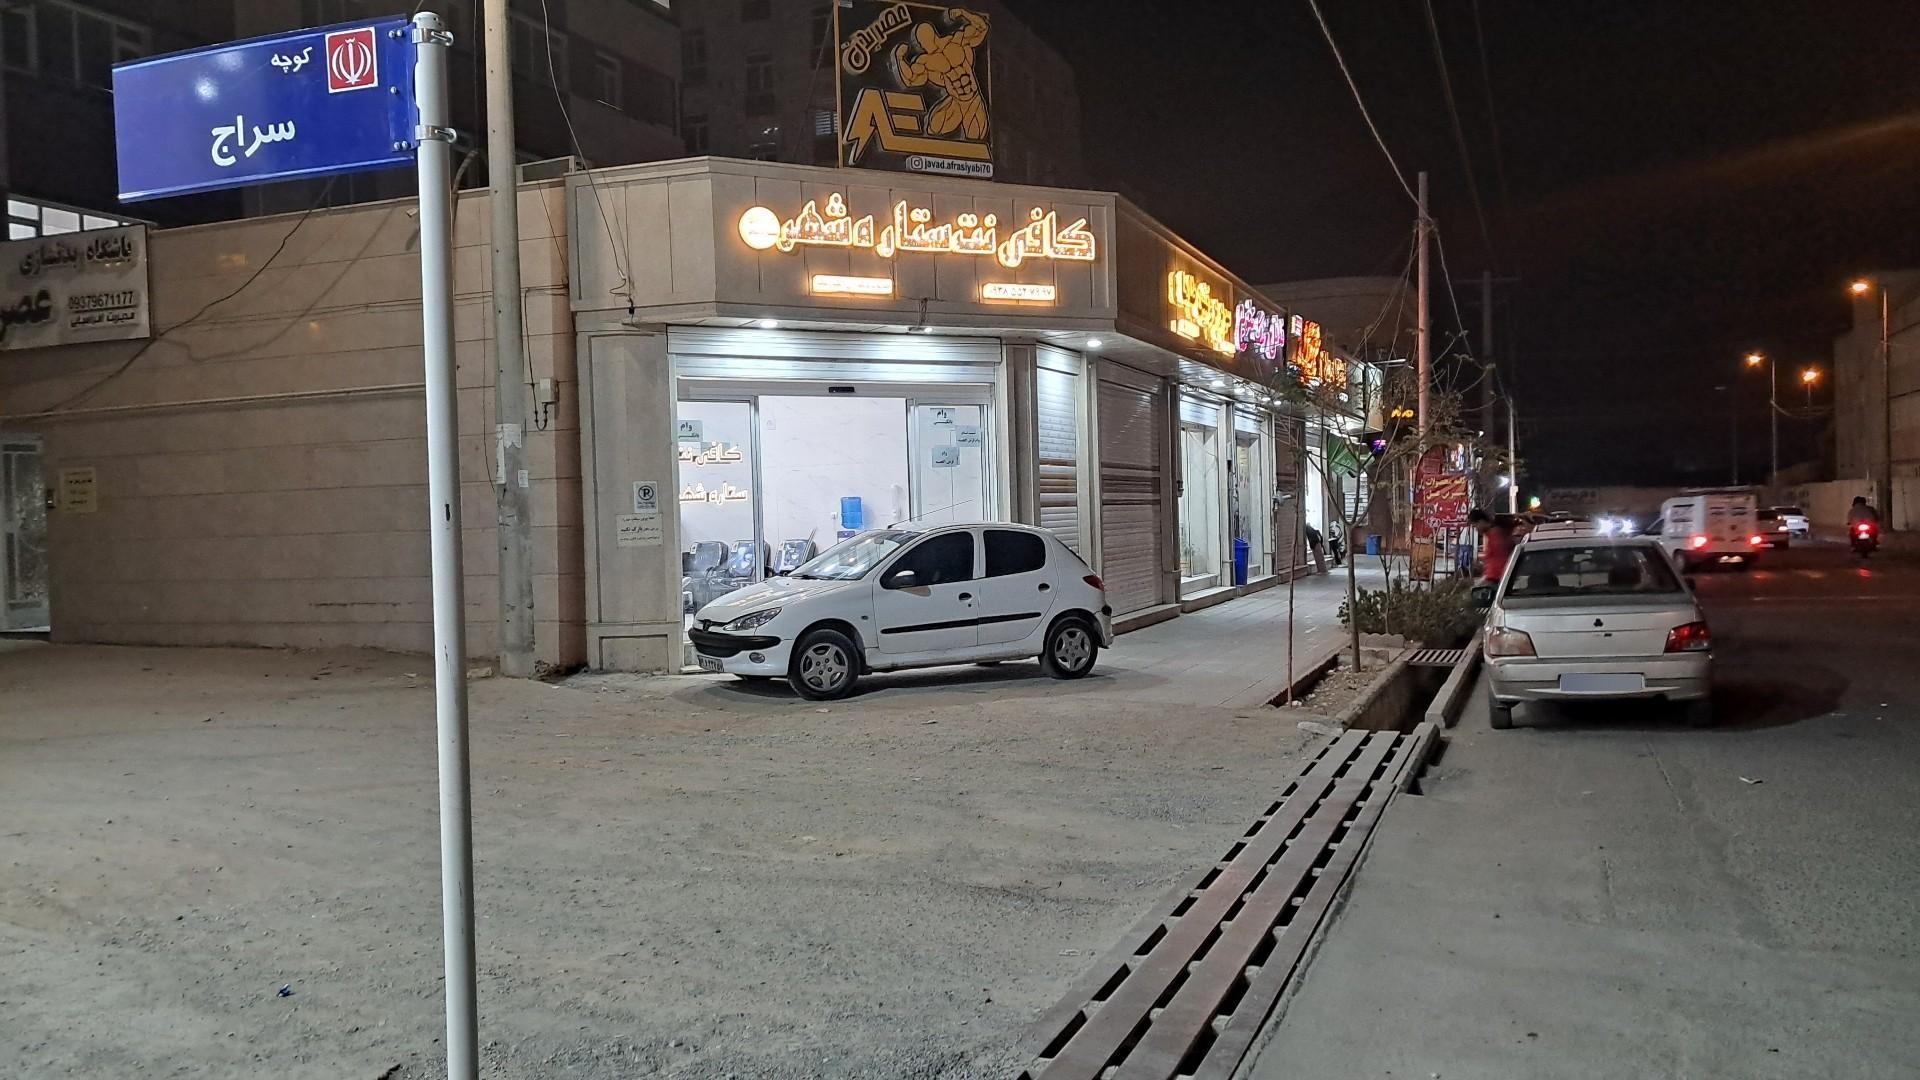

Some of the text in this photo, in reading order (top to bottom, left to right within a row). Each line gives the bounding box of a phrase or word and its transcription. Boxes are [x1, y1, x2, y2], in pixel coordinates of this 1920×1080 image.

[271, 46, 313, 73] کوچه
[211, 115, 296, 167] سراج
[924, 158, 991, 174] javad.afrasiyabi70
[776, 192, 1096, 267] کافی نت ستاره شهر
[86, 235, 132, 262] باشگاه
[69, 291, 134, 310] 09379671177
[936, 409, 948, 419] وام
[680, 422, 693, 432] وام
[695, 441, 743, 467] کافی
[678, 482, 748, 506] ستاره شه
